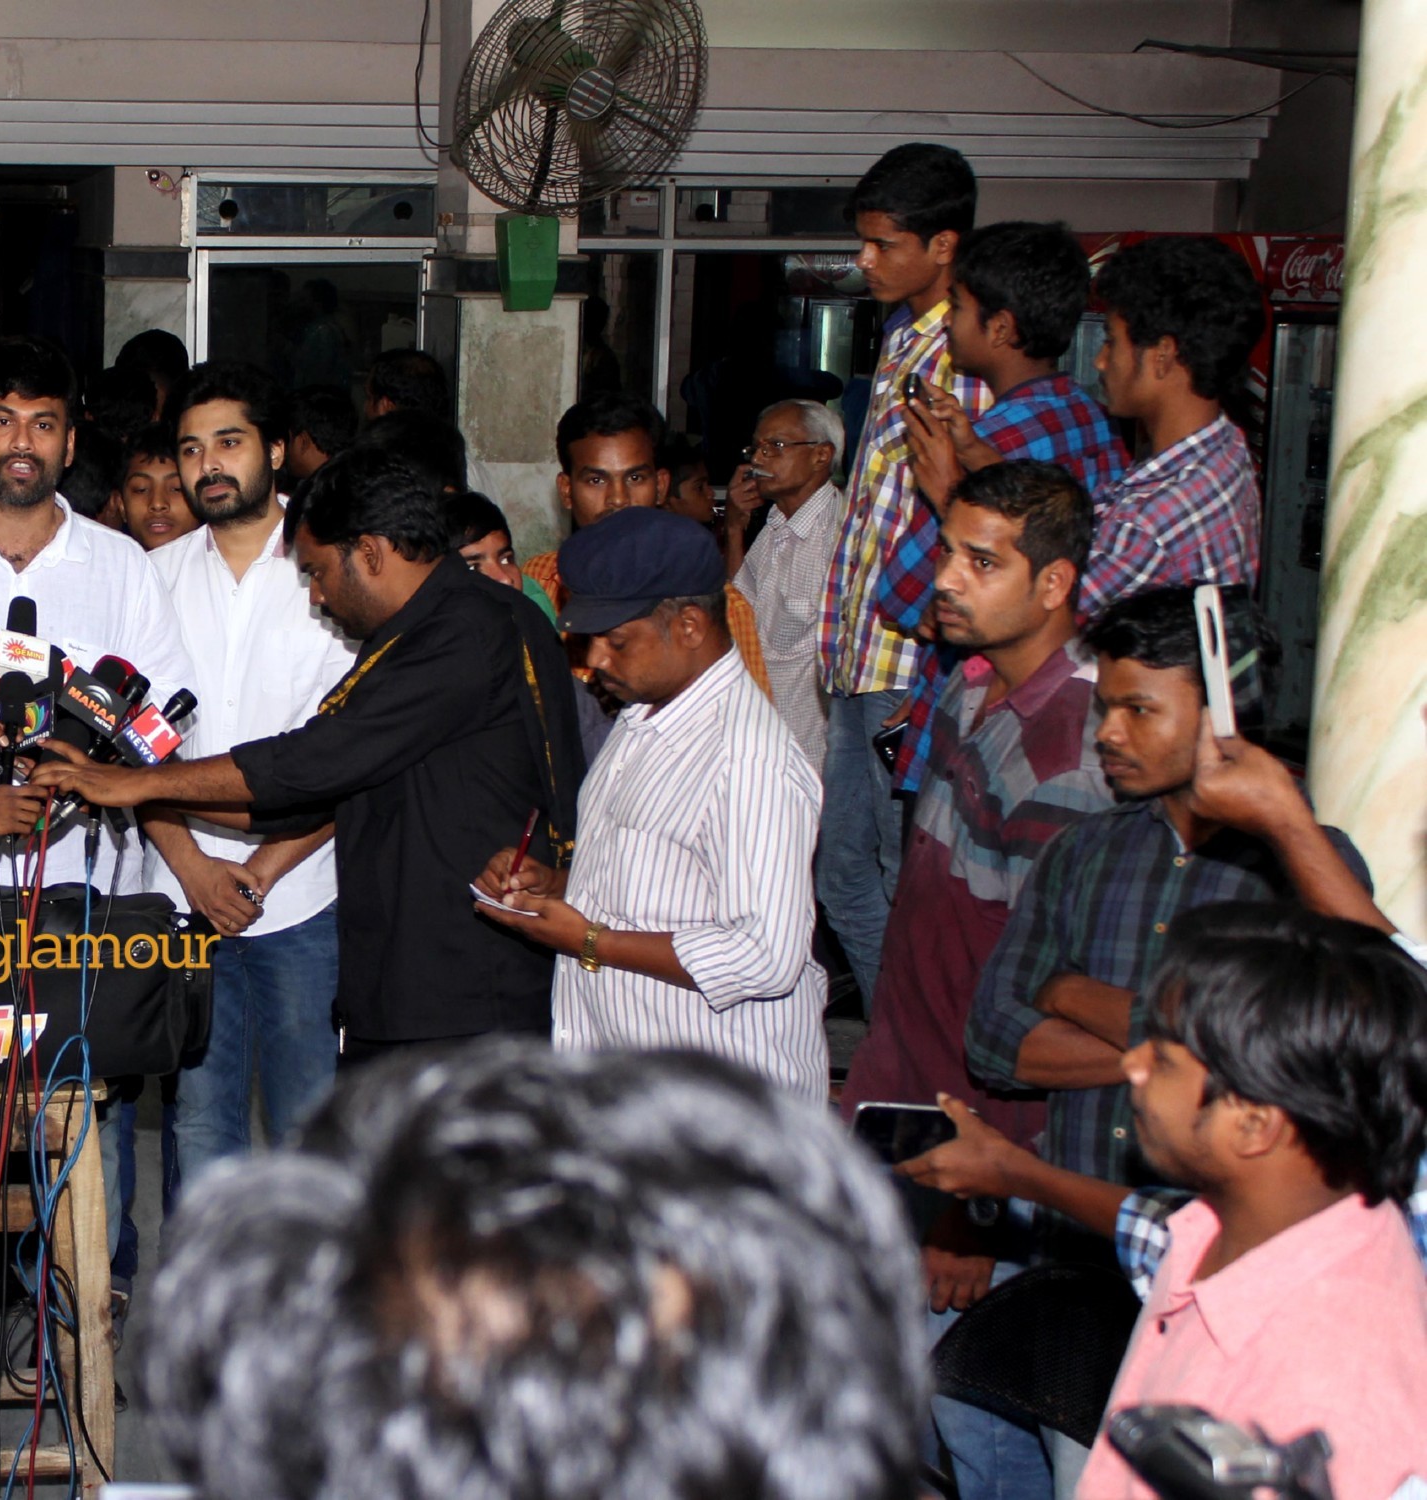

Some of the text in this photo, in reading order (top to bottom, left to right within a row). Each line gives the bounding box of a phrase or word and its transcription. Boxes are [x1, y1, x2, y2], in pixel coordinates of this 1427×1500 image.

[13, 646, 45, 661] GEMINI
[68, 686, 117, 726] MAHAA
[93, 715, 113, 732] NEWS
[125, 728, 157, 764] NEWS
[141, 712, 176, 748] T
